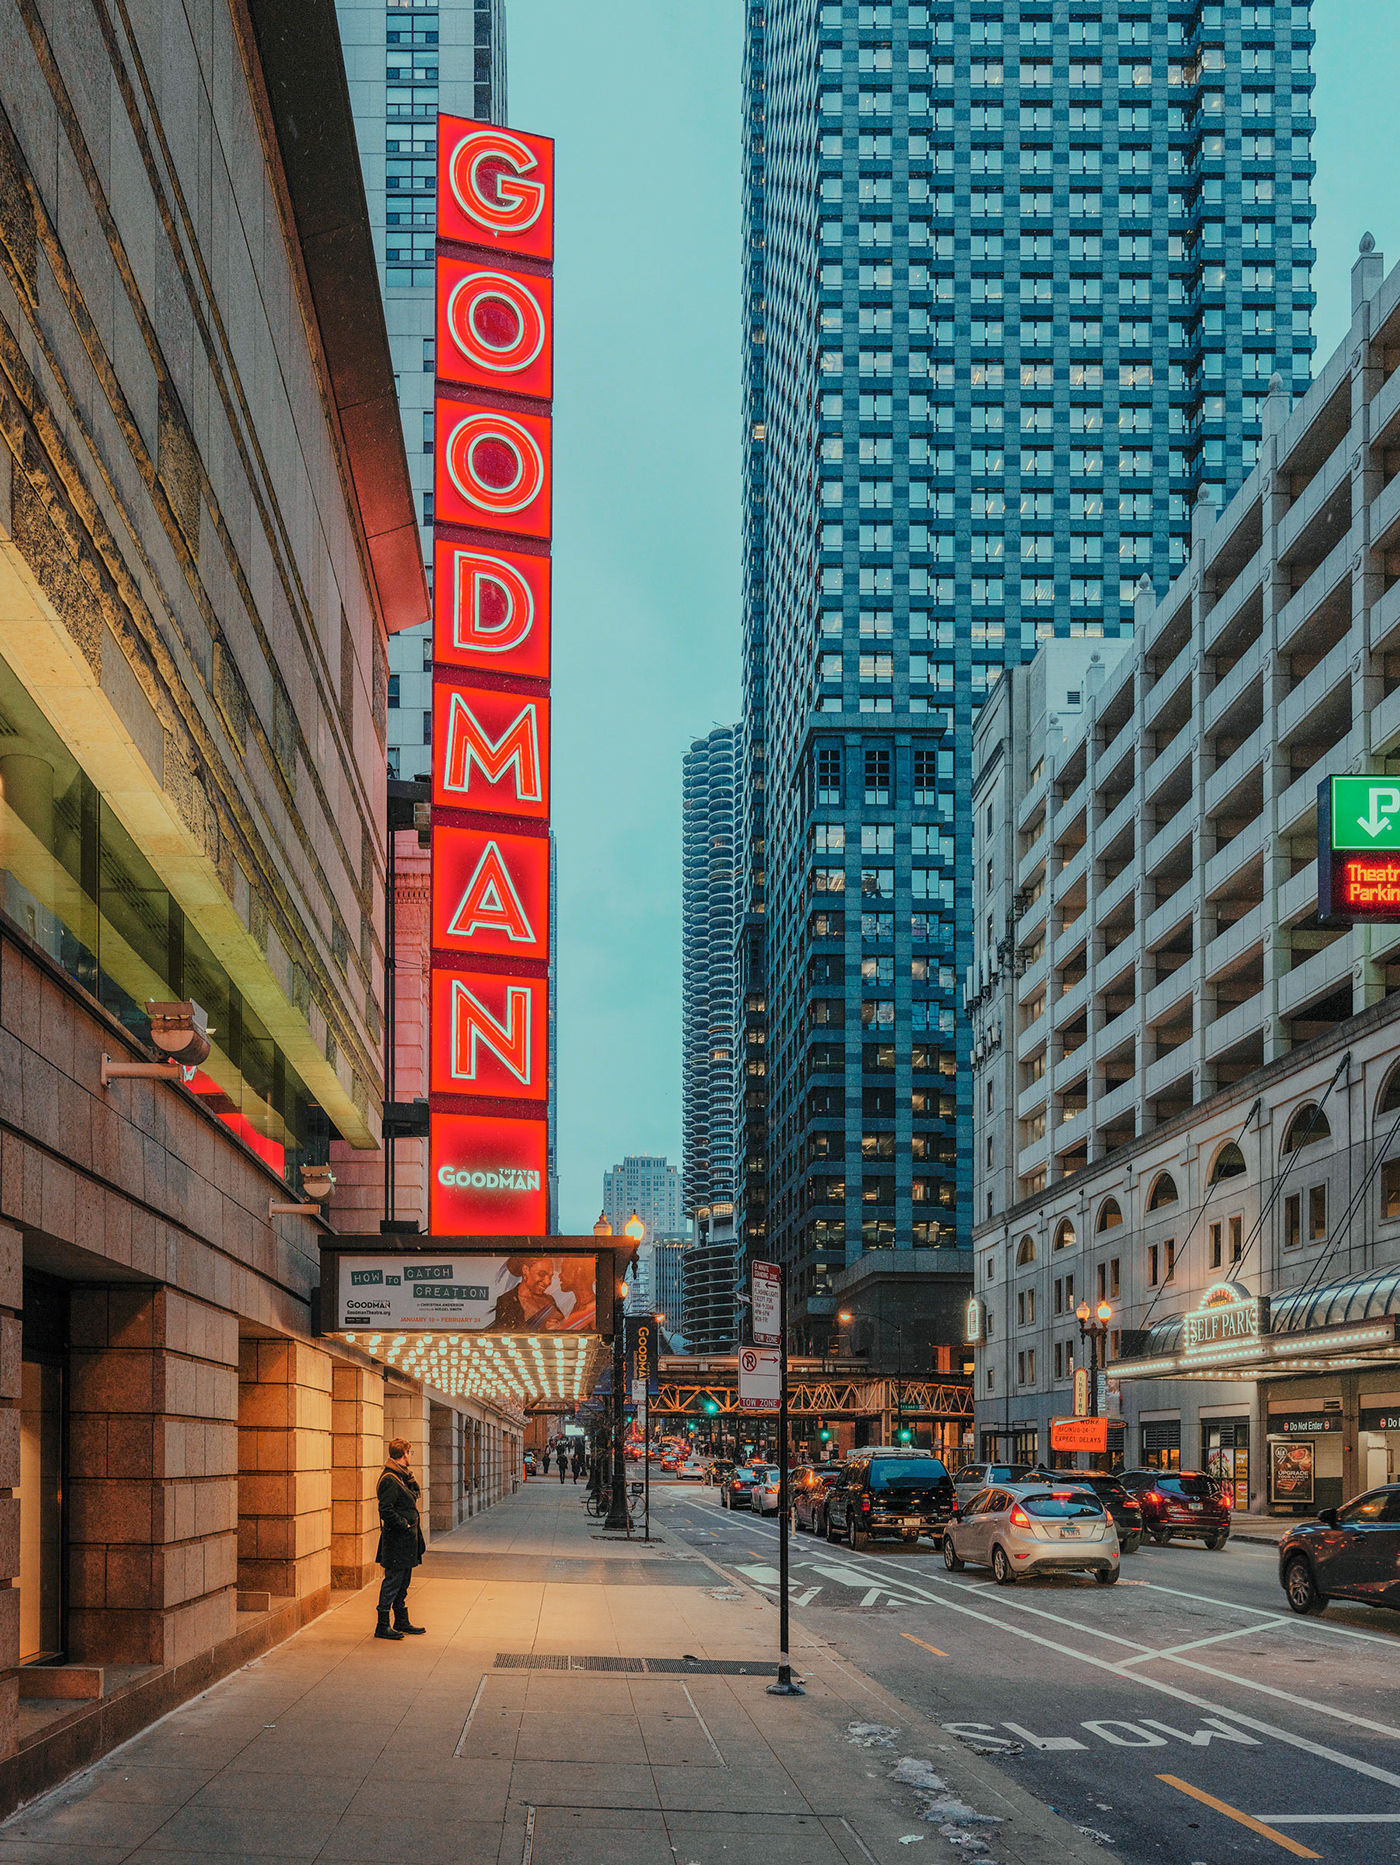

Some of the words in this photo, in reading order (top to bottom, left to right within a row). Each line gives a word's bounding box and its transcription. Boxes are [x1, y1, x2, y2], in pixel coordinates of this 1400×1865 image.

[443, 130, 546, 1085] GOODMAN
[354, 1272, 380, 1283] HOW
[388, 1276, 399, 1284] TO
[406, 1267, 451, 1279] CATCH
[769, 1273, 778, 1281] ZONE
[415, 1286, 487, 1298] CREATION
[1190, 1315, 1220, 1343] SELF
[1221, 1308, 1254, 1337] PARK
[765, 1335, 778, 1343] ZONE
[638, 1326, 649, 1381] GOODMA
[741, 1398, 757, 1407] TOW
[759, 1400, 778, 1408] ZONE
[1290, 1422, 1298, 1431] Do
[1298, 1422, 1308, 1431] Not
[1308, 1421, 1323, 1430] Enter
[1388, 1418, 1398, 1427] Do
[941, 1718, 1264, 1751] SLOW
